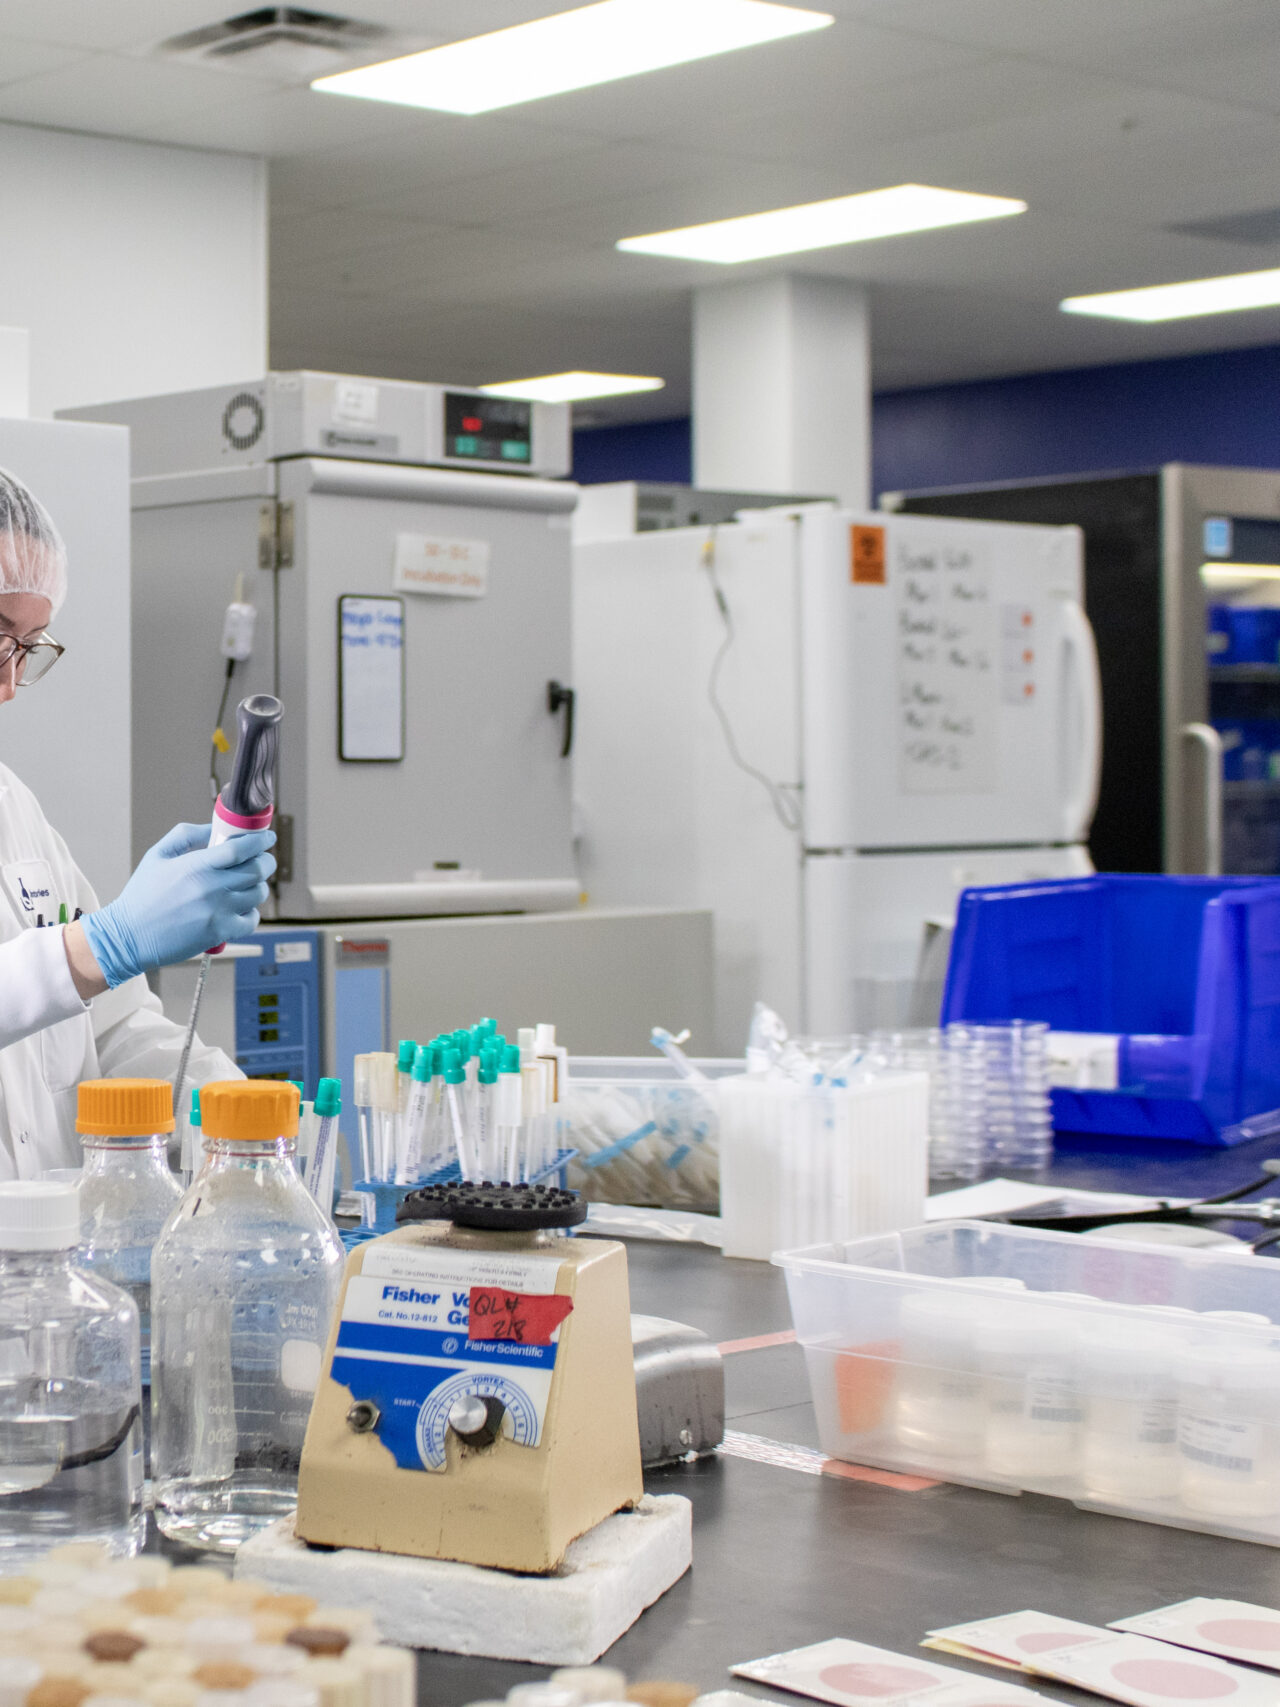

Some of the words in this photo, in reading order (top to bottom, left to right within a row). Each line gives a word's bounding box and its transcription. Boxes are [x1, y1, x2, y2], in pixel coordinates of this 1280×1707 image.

[342, 940, 389, 953] Thermo
[382, 1286, 440, 1305] Fisher
[472, 1375, 505, 1388] VORTEX
[393, 1397, 416, 1407] START
